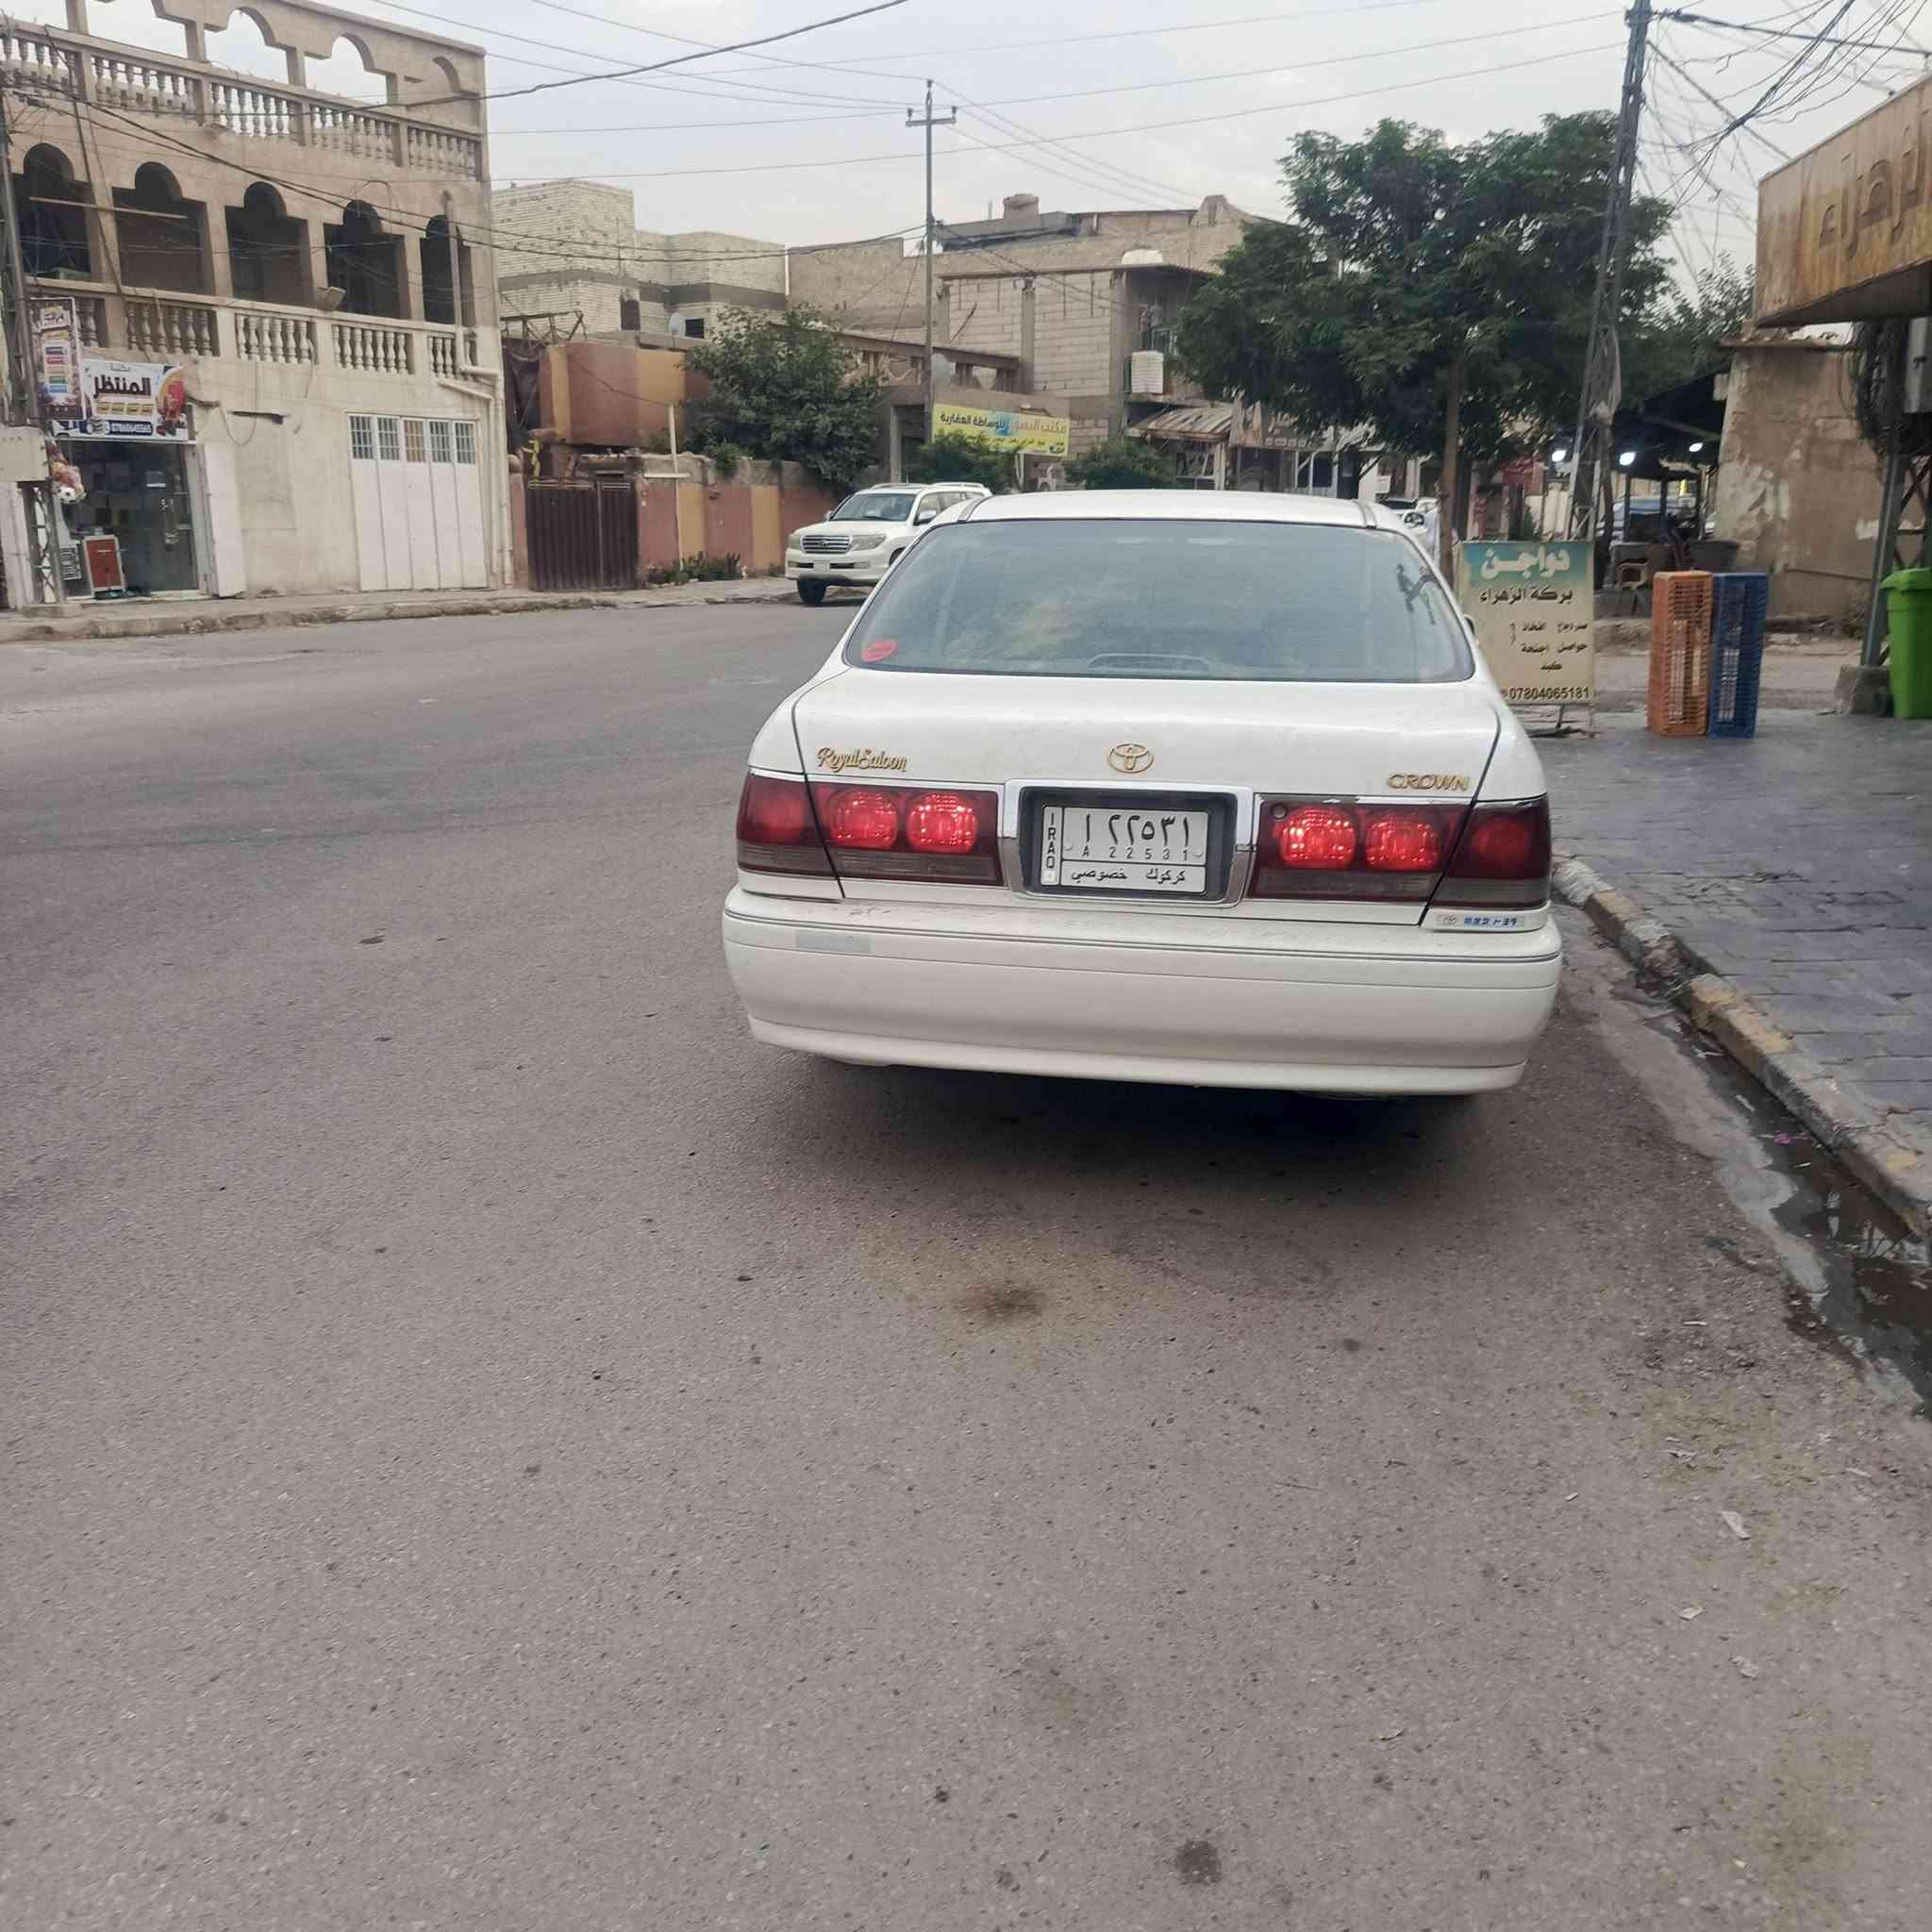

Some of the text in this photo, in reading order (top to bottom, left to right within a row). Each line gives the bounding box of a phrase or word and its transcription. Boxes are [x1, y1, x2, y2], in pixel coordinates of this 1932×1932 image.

[1818, 106, 1932, 260] لزهراء
[93, 375, 152, 399] المنتظر
[1480, 545, 1571, 579] دواجن
[1479, 585, 1574, 605] بركة الزهراء
[1541, 661, 1562, 673] كبد
[817, 747, 907, 773] Royal Saloon
[1388, 774, 1471, 791] CROWN
[1072, 868, 1186, 885] كركوك خصوصي
